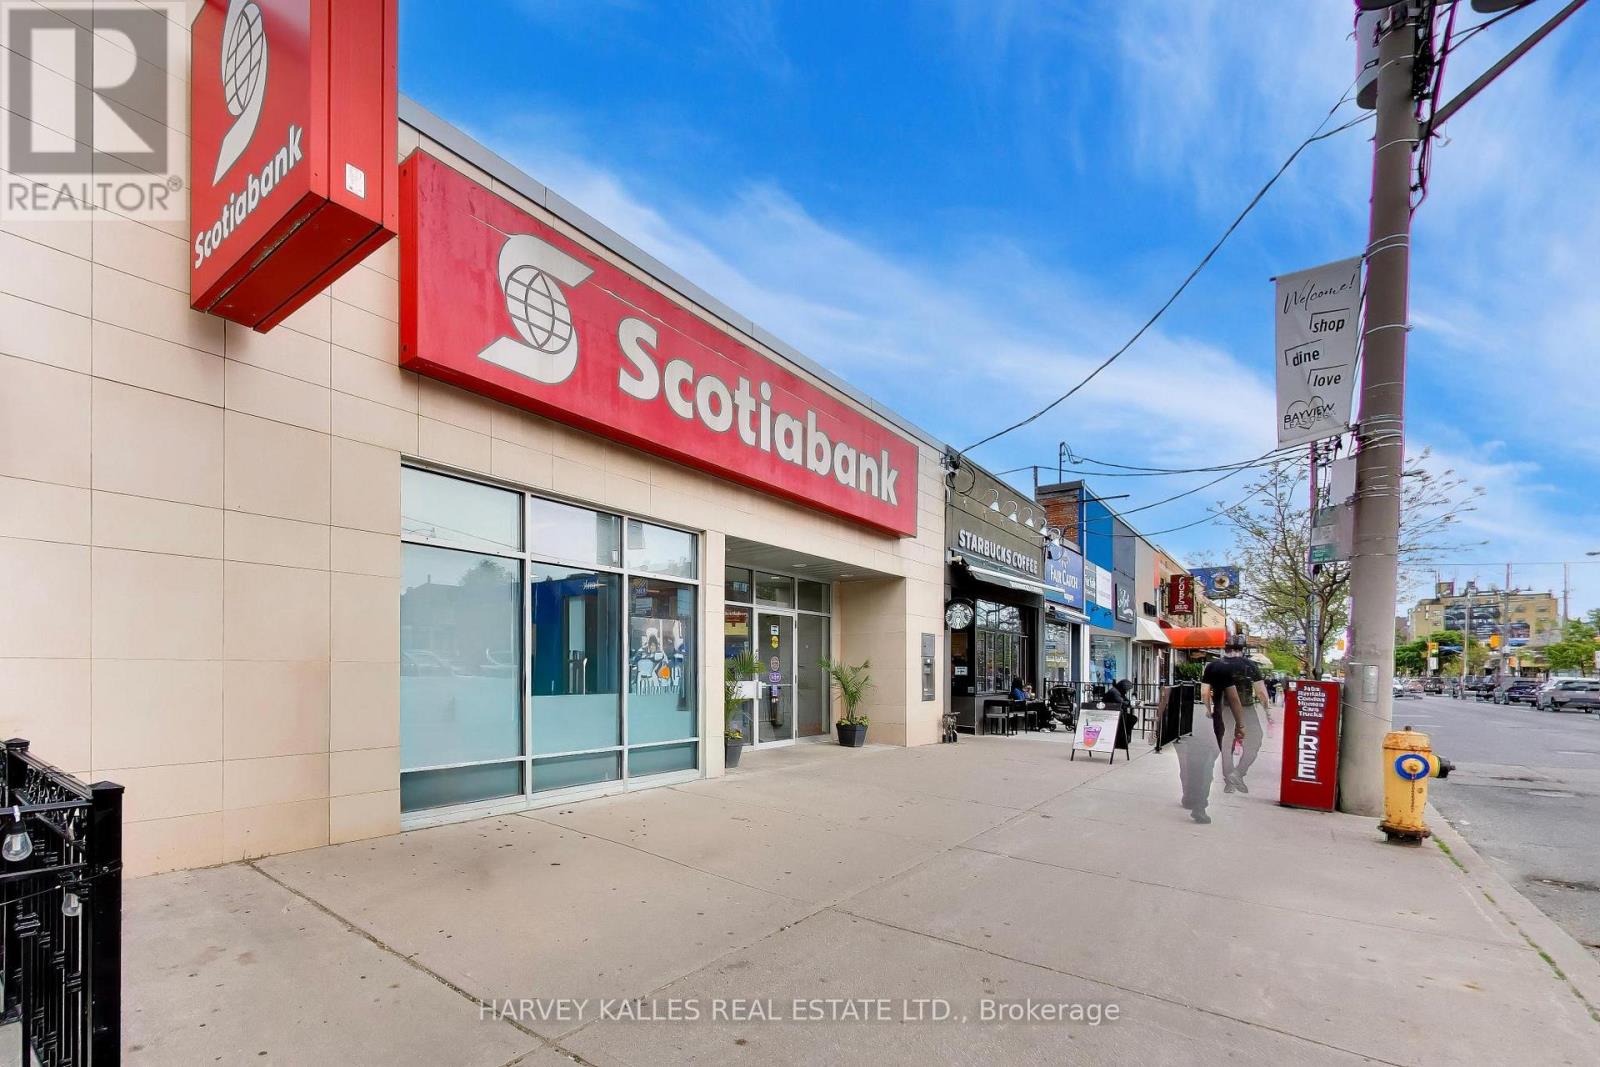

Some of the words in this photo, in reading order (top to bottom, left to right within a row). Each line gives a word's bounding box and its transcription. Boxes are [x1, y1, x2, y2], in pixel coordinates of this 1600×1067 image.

[194, 125, 302, 269] Scotiabank
[1283, 273, 1356, 314] Welcome!
[1312, 319, 1345, 333] shop
[1292, 350, 1320, 367] dine
[1313, 374, 1341, 387] love
[617, 316, 899, 506] Scotiabank
[1284, 402, 1335, 423] BAYVIEW
[959, 529, 1012, 565] STARBUCKS
[1012, 551, 1038, 575] COFFEE
[1297, 720, 1320, 780] FREE
